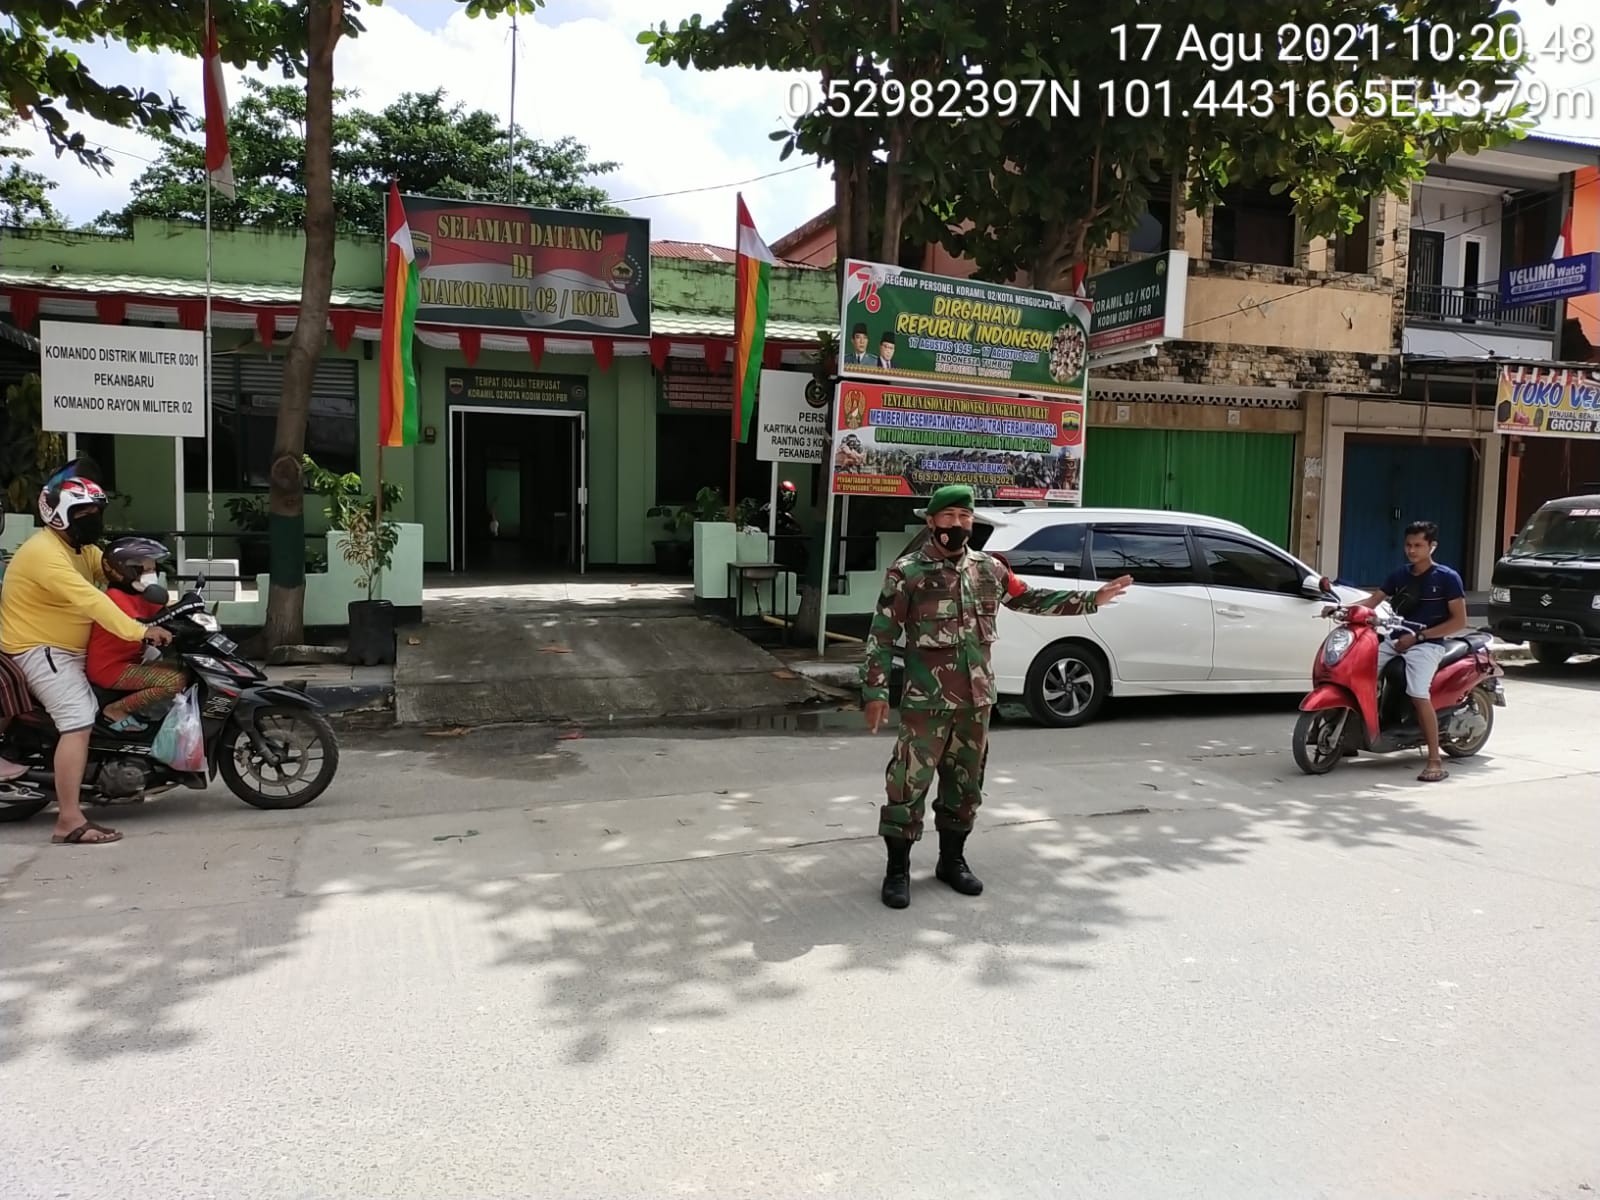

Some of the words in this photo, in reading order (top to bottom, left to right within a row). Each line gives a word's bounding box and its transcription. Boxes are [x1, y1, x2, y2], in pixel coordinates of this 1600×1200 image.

[438, 214, 525, 246] SELAMAT
[530, 223, 603, 252] DATANG
[512, 254, 534, 280] DI
[1509, 263, 1555, 287] VELLINA
[1556, 263, 1587, 278] Watch
[420, 277, 532, 312] MAKORAMIL
[535, 287, 557, 313] 02
[571, 289, 619, 318] KOTA
[885, 273, 918, 289] SEGENAP
[920, 279, 955, 295] PERSONEL
[956, 285, 986, 299] KORAMIL
[987, 290, 1014, 304] 02/KOTA
[1140, 284, 1160, 301] KOTA
[934, 296, 1022, 327] DIRGAHAYU
[1097, 312, 1118, 329] KODIM
[1138, 304, 1152, 317] PBR
[896, 314, 974, 342] REPUBLIK
[976, 325, 1053, 353] INDONESIA
[45, 345, 97, 361] KOMANDO
[99, 348, 137, 363] DISTRIK
[139, 351, 177, 365] MILITER
[179, 354, 199, 367] 0301
[919, 340, 953, 353] AGUSTUS
[954, 343, 972, 355] 1945
[991, 348, 1021, 360] AGUSTUS
[936, 353, 980, 366] INDONESIA
[94, 373, 154, 388] PEKANBARU
[475, 376, 500, 388] TEMPAT
[501, 378, 527, 389] ISOLASI
[528, 379, 561, 391] TERPUSAT
[467, 389, 495, 399] KORAMIL
[1511, 380, 1563, 408] TOKO
[53, 395, 104, 410] KOMANDO
[107, 398, 140, 412] RAYON
[142, 401, 180, 414] MILITER
[182, 401, 193, 414] 02
[883, 392, 917, 409] TENTARA
[918, 396, 952, 412] NASIONAL
[991, 402, 1026, 418] ANGKATAN
[799, 411, 825, 423] PERS
[871, 409, 903, 426] MEMBERI
[904, 411, 950, 430] KESEMPATAN
[951, 415, 979, 432] KEPADA
[980, 418, 1001, 434] PUTRA
[1031, 423, 1058, 438] BANGSA
[1550, 419, 1592, 432] GROSIR
[764, 423, 797, 434] KARTIKA
[875, 427, 903, 444] UNTUK
[772, 435, 805, 447] RANTING
[807, 437, 811, 447] 3
[921, 459, 977, 473] PENDAFTARAN
[978, 462, 1008, 474] DIBUKA
[955, 473, 994, 484] AGUSTUS
